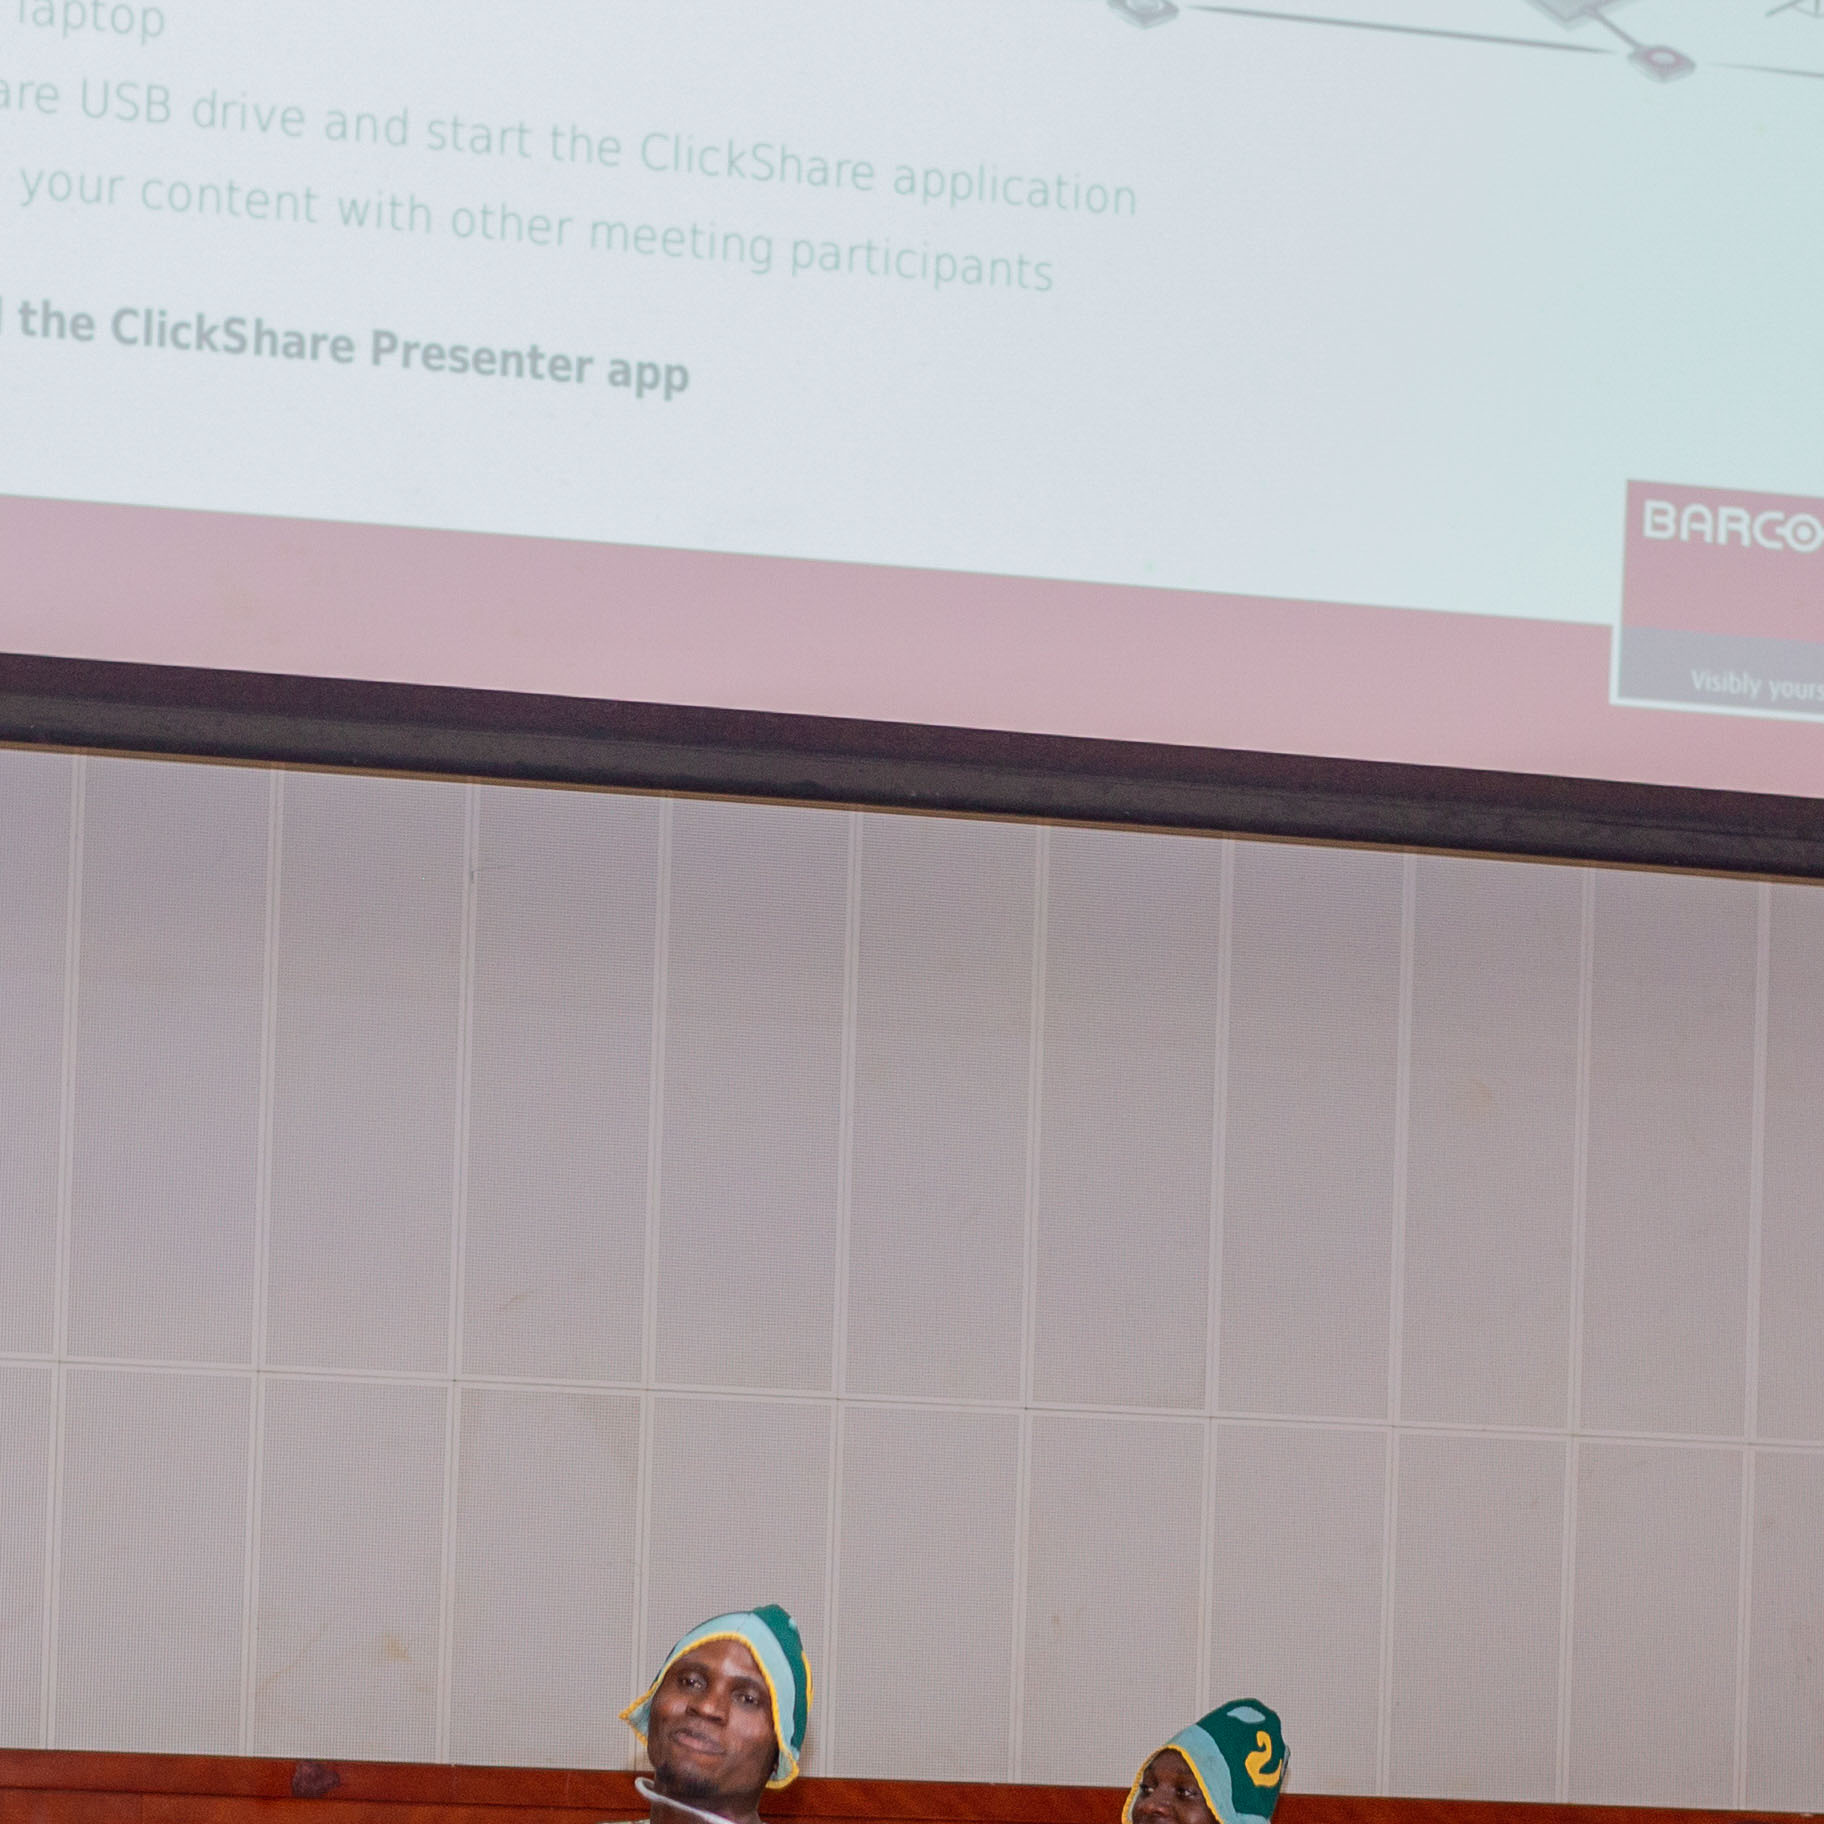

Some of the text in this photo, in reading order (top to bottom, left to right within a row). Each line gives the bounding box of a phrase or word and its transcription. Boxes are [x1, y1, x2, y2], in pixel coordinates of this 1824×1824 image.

[81, 78, 171, 125] USB
[192, 89, 306, 139] drive
[324, 107, 409, 148] and
[427, 114, 532, 158] start
[550, 123, 622, 168] the
[640, 131, 875, 192] ClickShare
[893, 163, 1137, 216] application
[19, 168, 125, 208] your
[141, 178, 319, 224] content
[337, 194, 432, 234] with
[451, 202, 574, 247] other
[590, 219, 774, 276] meeting
[791, 239, 1054, 293] participants
[17, 298, 97, 343] the
[110, 306, 357, 365] ClickShare
[370, 328, 596, 385] Presenter
[606, 357, 691, 403] app
[1690, 669, 1762, 698] Visibly
